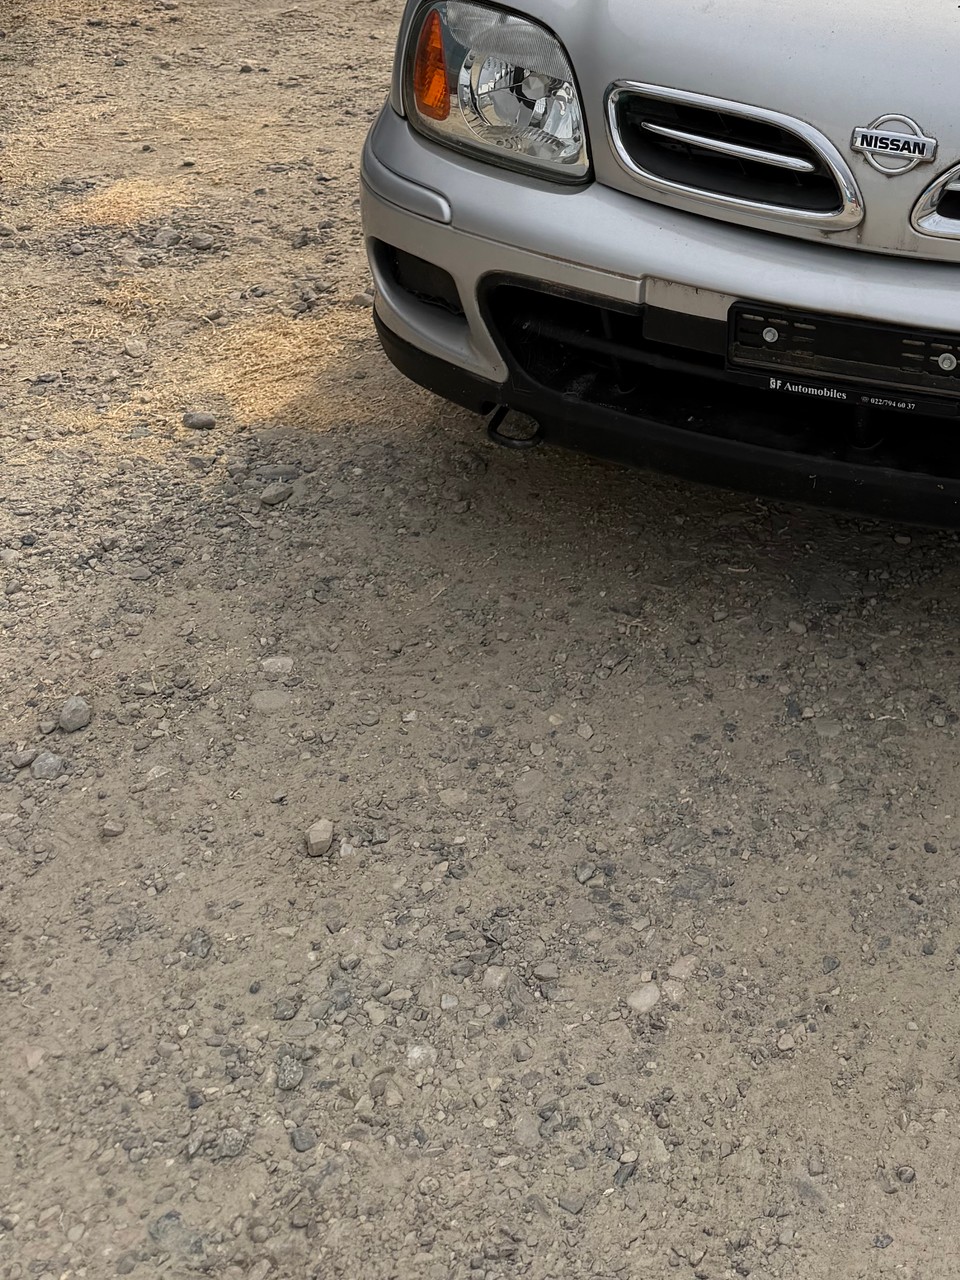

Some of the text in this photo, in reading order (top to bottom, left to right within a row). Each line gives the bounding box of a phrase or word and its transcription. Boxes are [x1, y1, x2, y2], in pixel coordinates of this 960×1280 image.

[860, 134, 926, 156] NISSAN
[784, 382, 847, 399] Automobiles
[870, 397, 896, 407] 022/794
[907, 402, 916, 410] 37
